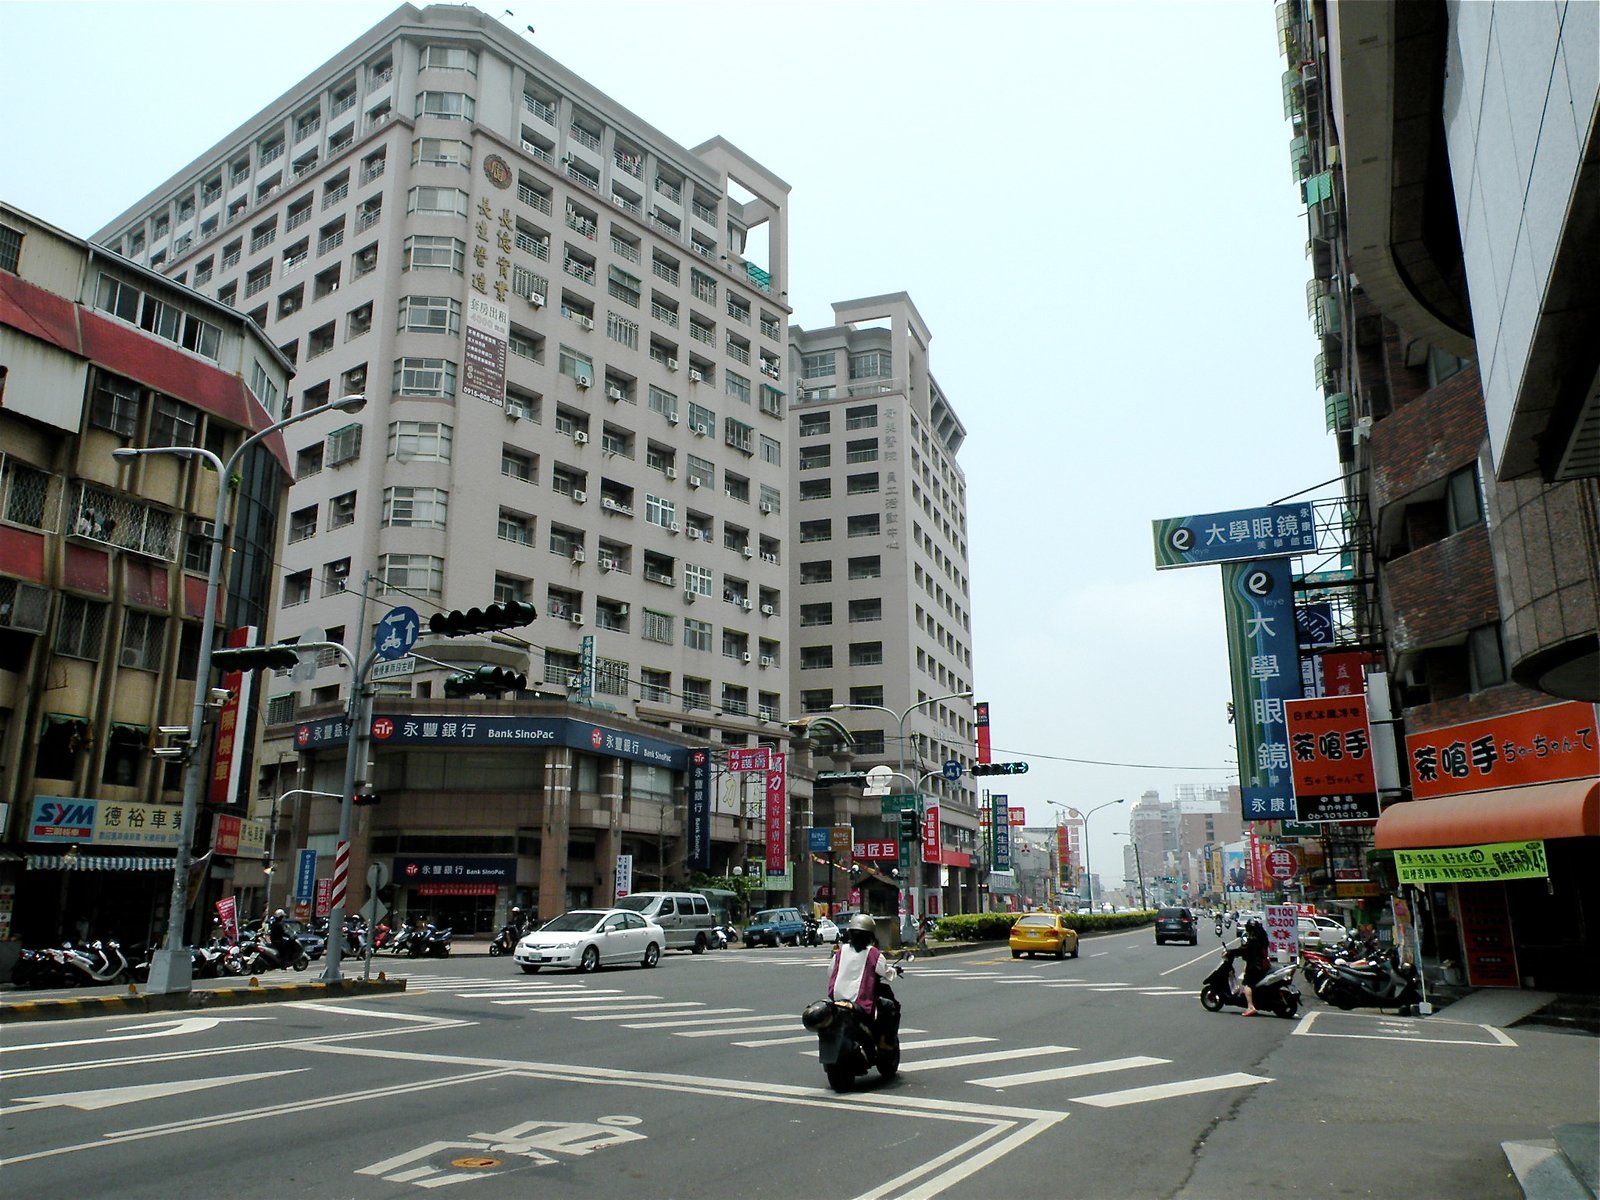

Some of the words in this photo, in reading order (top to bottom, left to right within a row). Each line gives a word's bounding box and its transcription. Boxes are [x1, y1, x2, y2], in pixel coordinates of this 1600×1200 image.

[470, 298, 507, 324] 套房出租
[1205, 515, 1300, 546] 大學眼鏡
[1300, 508, 1313, 545] 永康店
[1247, 611, 1289, 770] 大學眼鏡
[403, 722, 476, 738] 永豐銀行
[488, 729, 513, 738] Bank
[515, 729, 554, 739] SinoPac
[606, 734, 639, 755] 永豐銀行
[643, 748, 655, 759] Bank
[655, 751, 672, 763] SinoPac
[1292, 728, 1369, 761] 茶嗆手
[1414, 734, 1498, 782] 茶嗆手
[694, 767, 704, 813] 永豐銀行
[36, 803, 95, 825] SYM
[421, 865, 464, 875] 永豐銀行
[481, 868, 505, 876] SinoPac
